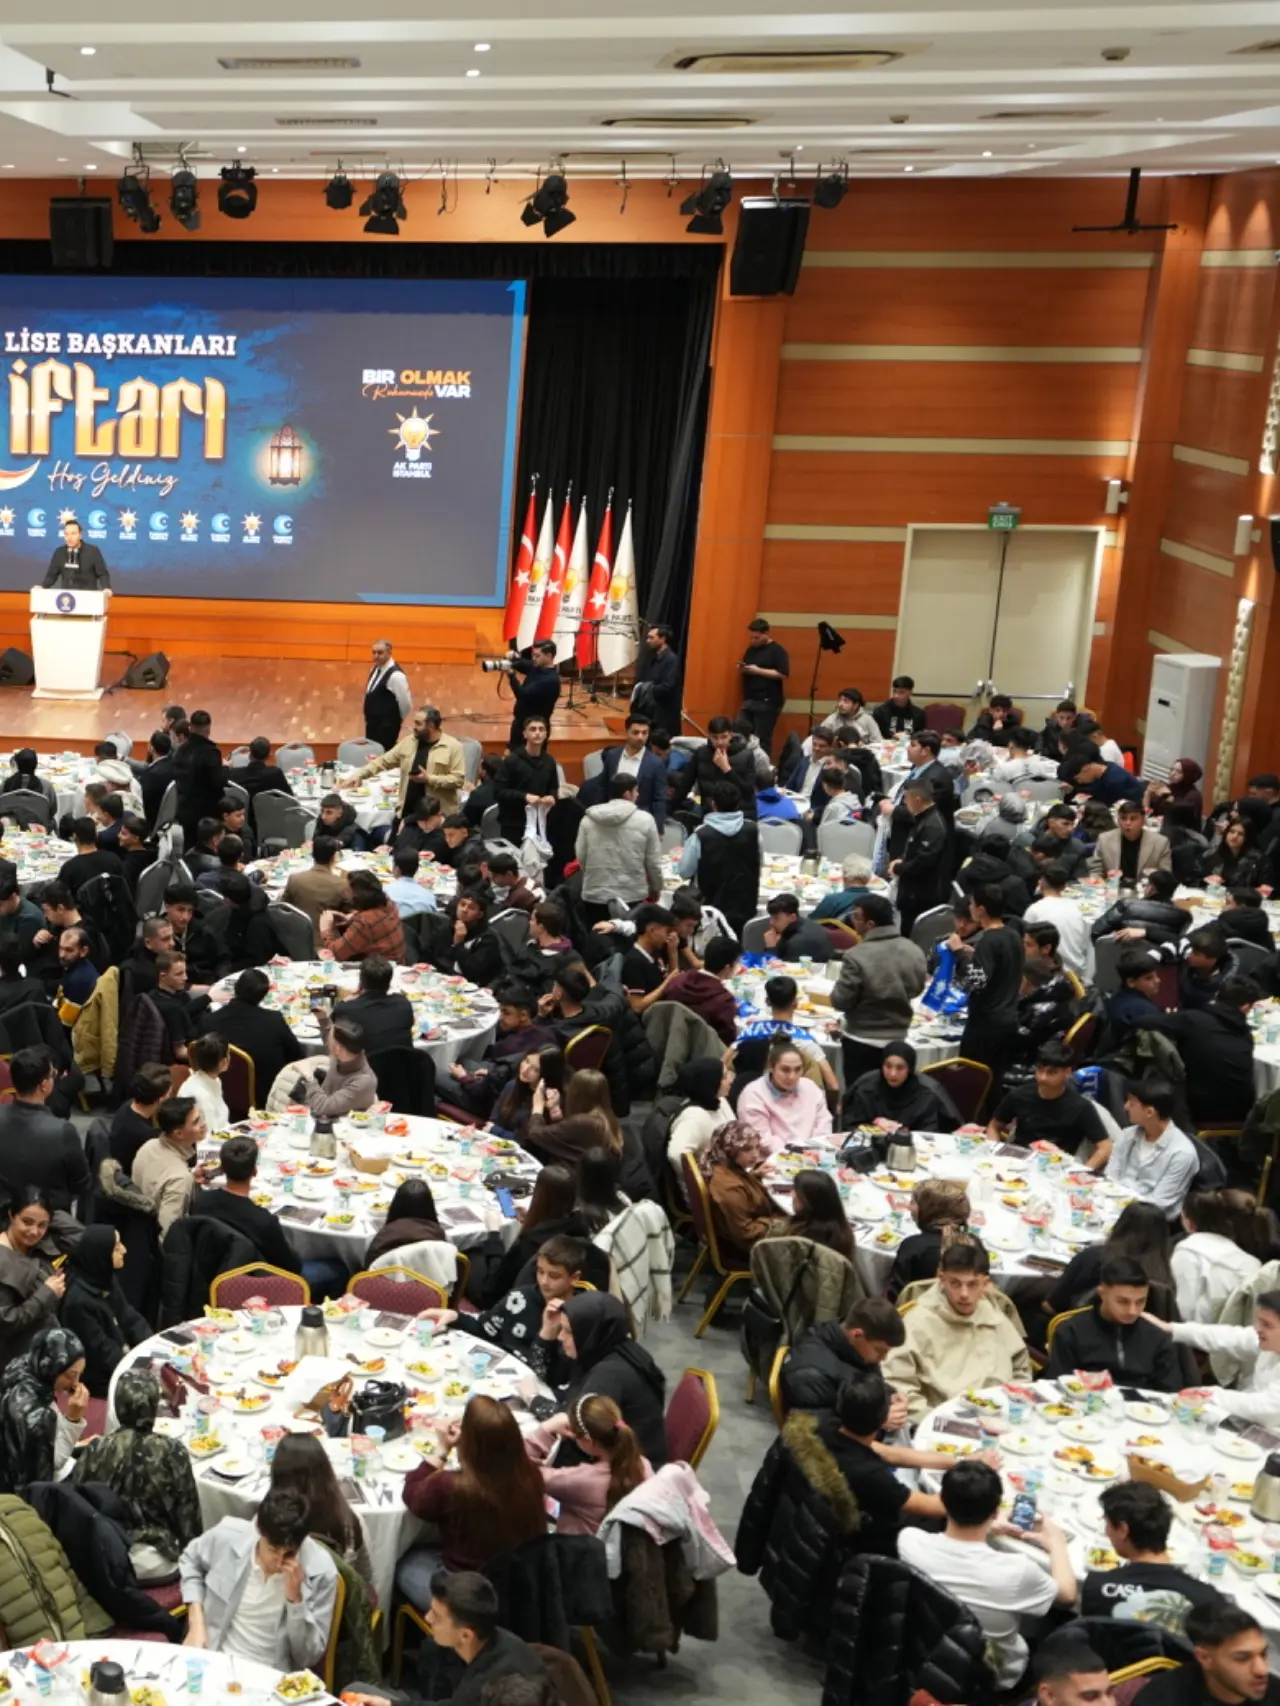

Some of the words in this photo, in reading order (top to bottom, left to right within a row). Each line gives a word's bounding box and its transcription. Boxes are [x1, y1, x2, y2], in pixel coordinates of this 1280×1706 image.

[4, 327, 61, 353] LİSE
[67, 332, 237, 359] BAŞKANLARI
[400, 370, 471, 385] OLMAK
[434, 384, 471, 398] VAR
[393, 461, 407, 470] AK
[47, 460, 88, 491] Hoş
[90, 461, 179, 498] Geldiniz
[1101, 1583, 1144, 1598] CASA
